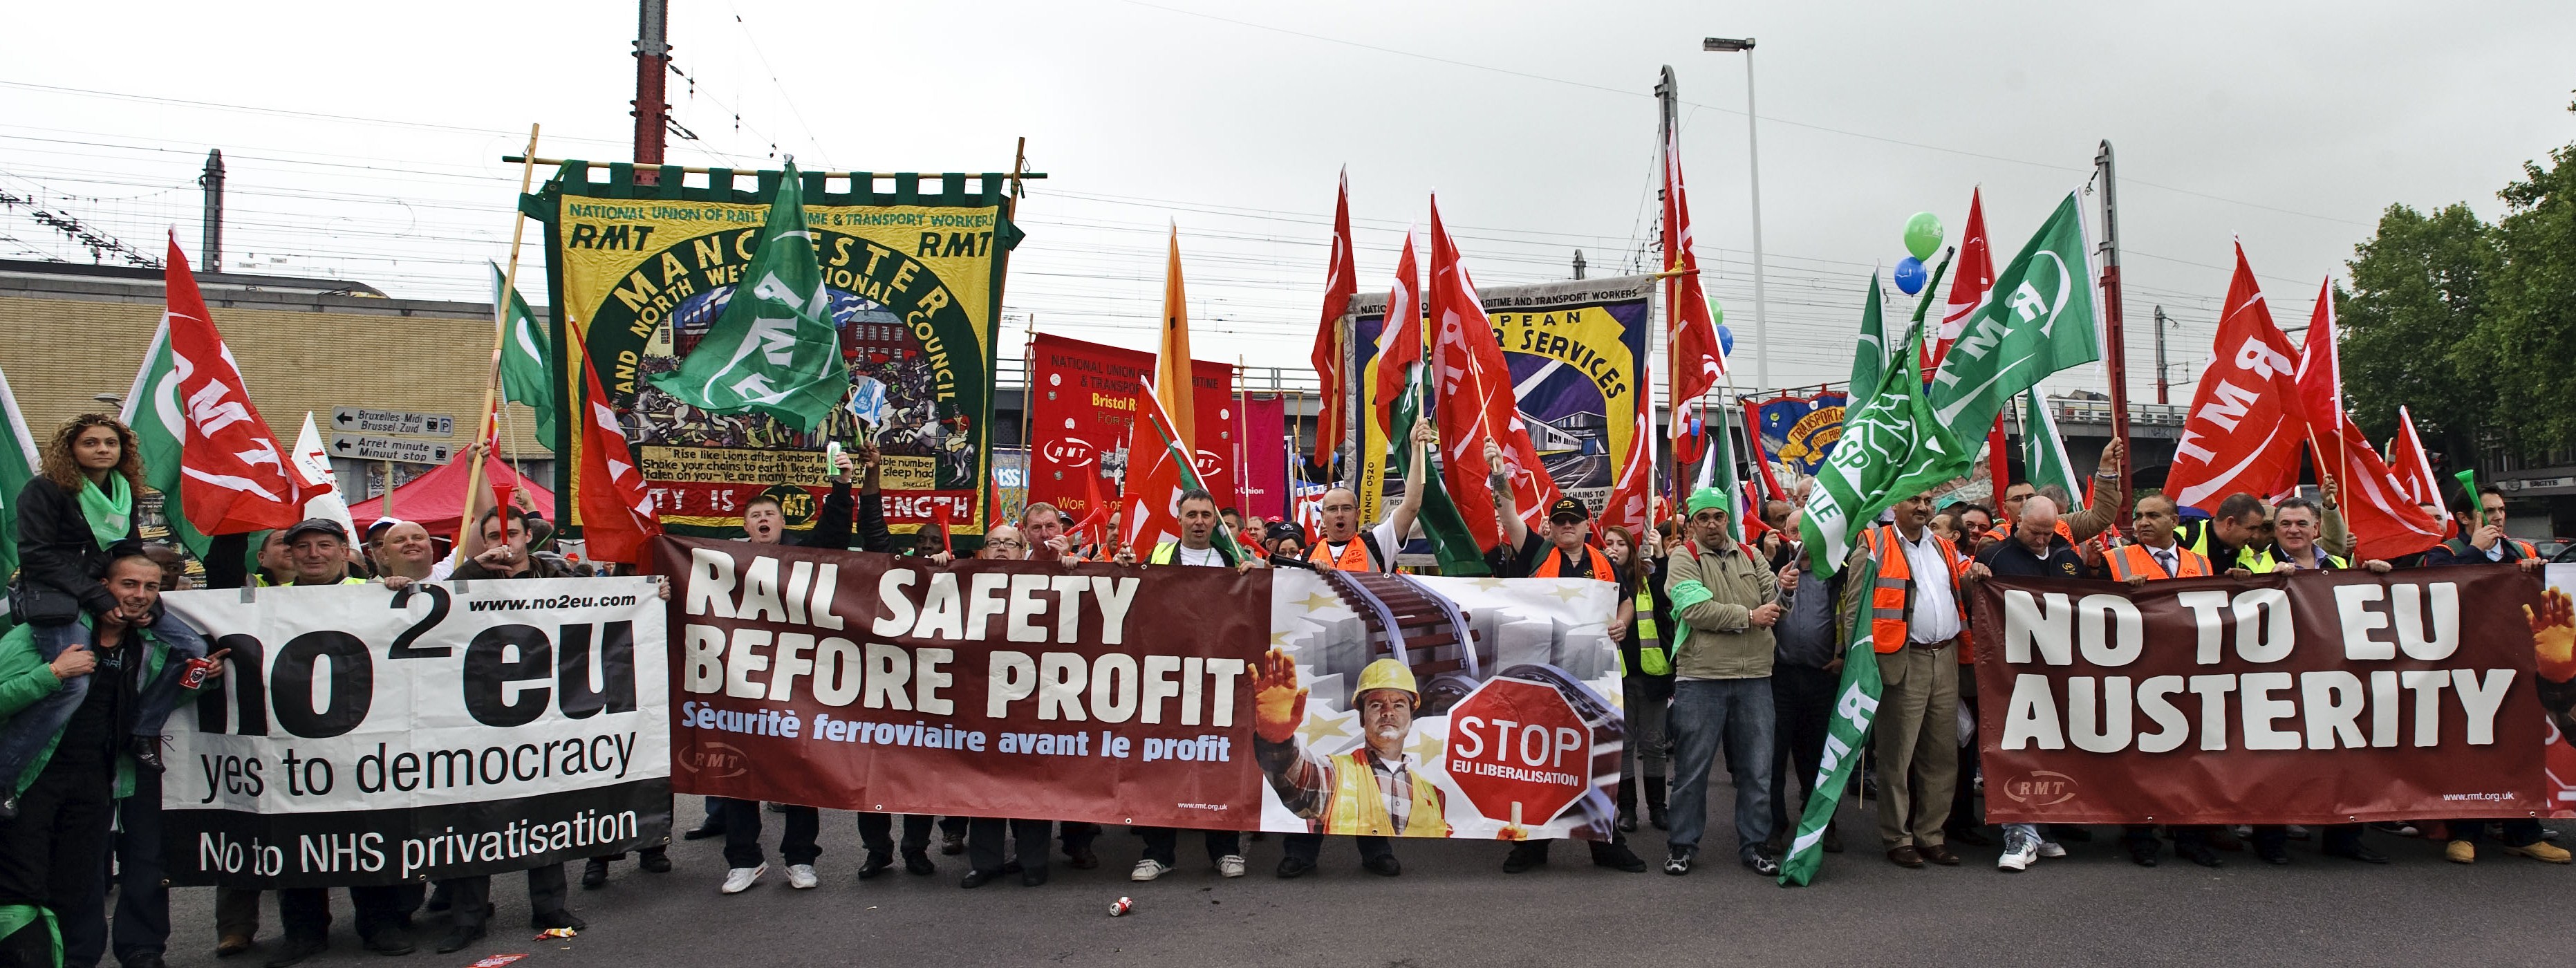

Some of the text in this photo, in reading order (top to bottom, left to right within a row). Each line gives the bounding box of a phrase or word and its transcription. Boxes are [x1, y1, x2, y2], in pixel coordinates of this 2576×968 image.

[570, 203, 645, 220] NATIONAL
[652, 207, 700, 221] UNION
[705, 208, 722, 221] OF
[727, 210, 757, 222] RAIL
[846, 213, 925, 226] TRANSPORT
[931, 213, 993, 227] WORKERS
[569, 223, 655, 251] RMT
[917, 232, 992, 258] RMT
[613, 229, 949, 319] MANCESTER
[1515, 296, 1531, 306] AND
[1536, 292, 1588, 305] TRANSPORT
[1592, 289, 1637, 301] WORKERS
[615, 351, 637, 394] AND
[629, 277, 695, 339] NORTH
[906, 310, 955, 402] COUNCIL
[1934, 279, 2048, 390] RMT
[1051, 355, 1103, 373] NATIONAL
[1107, 364, 1135, 380] UNION
[1520, 330, 1626, 398] SERVICES
[1092, 392, 1127, 410] Bristol
[2173, 334, 2295, 467] RMT
[1791, 408, 1838, 442] TRANSPORT
[358, 438, 429, 452] Arrêt minute
[359, 447, 427, 462] Minuut stop
[1054, 447, 1086, 458] RMT
[643, 459, 678, 470] Shake
[682, 462, 704, 472] your
[706, 461, 740, 471] chains
[744, 463, 755, 472] to
[758, 463, 787, 473] earth
[884, 468, 911, 479] sleep
[915, 468, 934, 478] had
[700, 449, 720, 460] like
[722, 450, 747, 461] Lions
[750, 451, 773, 462] after
[898, 457, 933, 468] number
[1197, 458, 1214, 468] MT
[644, 469, 673, 480] fallen
[677, 472, 691, 480] on
[738, 473, 755, 481] are
[711, 490, 735, 512] IS
[1364, 491, 1372, 524] BRANCH
[469, 595, 636, 611] www.no2eu.com
[686, 548, 1141, 644] RAIL SAFETY
[2004, 581, 2460, 667] NO TO EU
[684, 624, 1244, 727] BEFORE PROFIT
[2001, 669, 2517, 753] AUSTERITY
[682, 701, 1231, 762] Sècuritè ferroviaire avant le profit
[1455, 716, 1582, 767] STOP
[201, 732, 637, 804] yes to democracy
[694, 752, 738, 768] RMT
[1453, 760, 1578, 787] EU LIBERALISATION
[2019, 781, 2065, 795] RMT
[2443, 792, 2514, 802] www.rmt.org.uk
[1177, 802, 1228, 811] www.rmt.org.uk
[200, 808, 637, 879] No to NHS privatisation
